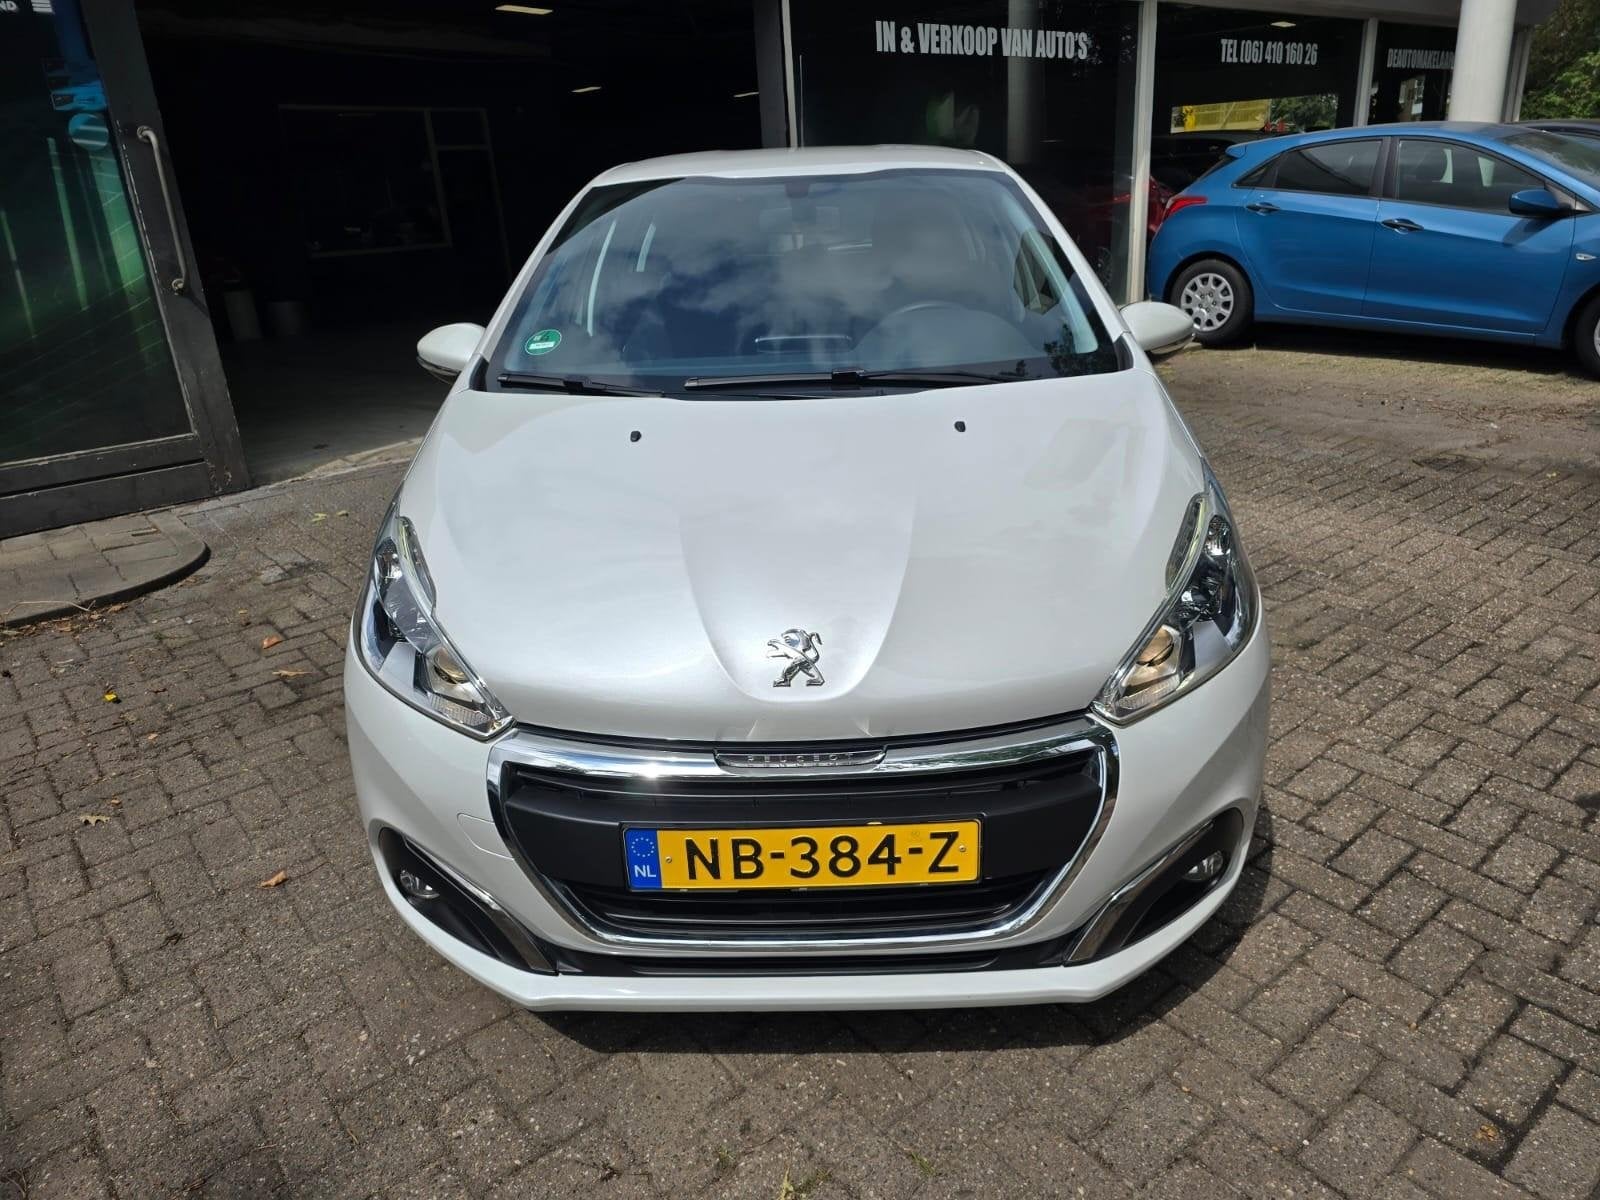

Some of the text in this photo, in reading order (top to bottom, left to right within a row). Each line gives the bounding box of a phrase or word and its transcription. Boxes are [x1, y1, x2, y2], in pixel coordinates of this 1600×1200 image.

[875, 20, 1088, 59] IN & VERKOOP VAN AUTO'S
[1220, 38, 1318, 65] TEL (06) 410 160 26
[634, 864, 657, 879] NL
[685, 830, 960, 881] NB-384-Z
